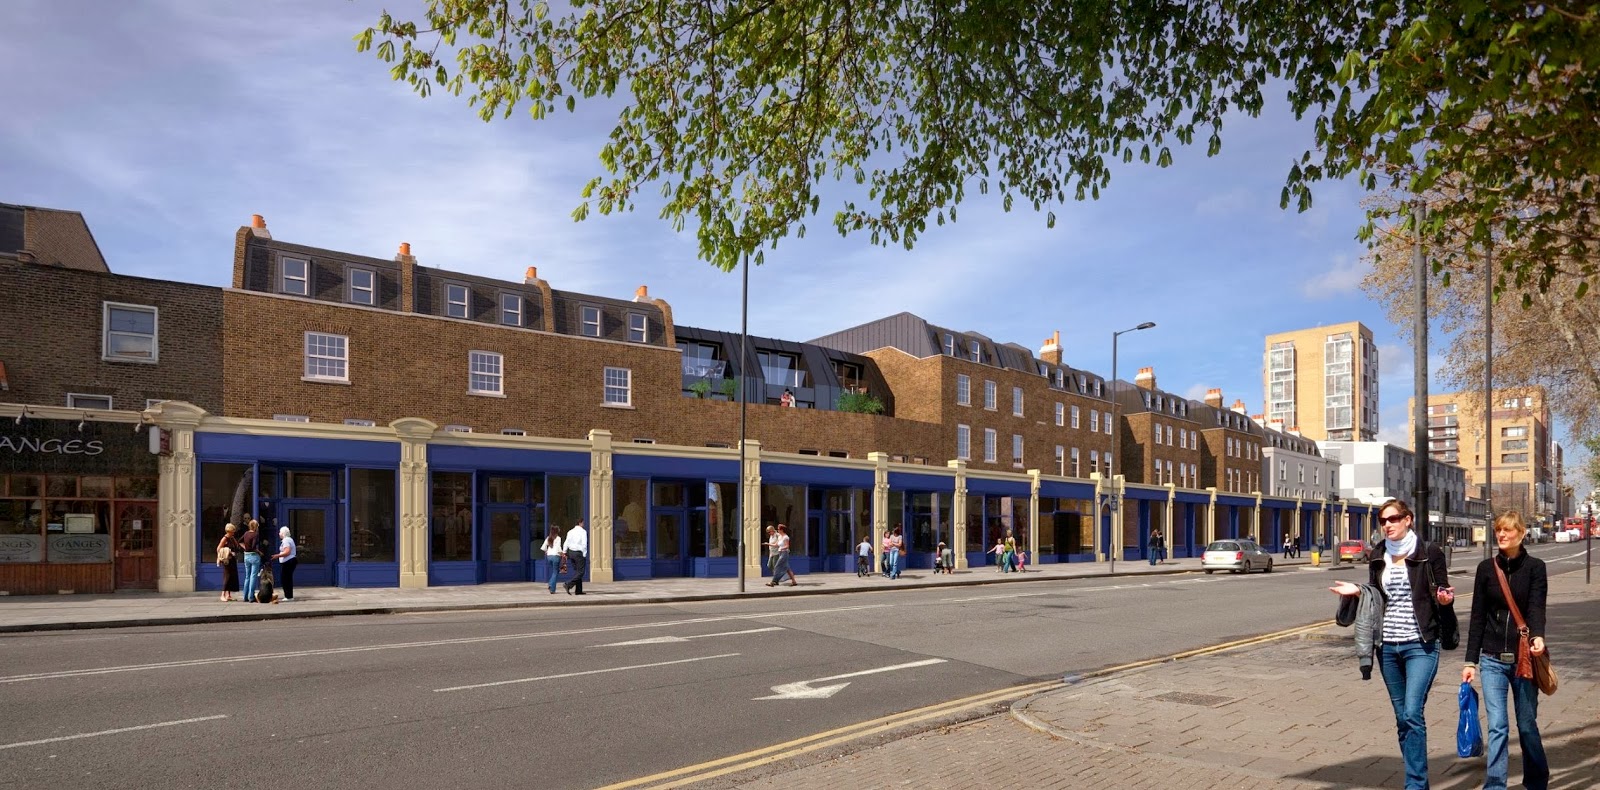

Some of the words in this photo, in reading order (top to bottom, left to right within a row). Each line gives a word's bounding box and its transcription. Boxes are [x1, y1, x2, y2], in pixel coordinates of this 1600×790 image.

[0, 436, 104, 456] ANGES
[0, 540, 33, 548] NGES
[55, 540, 102, 548] GANGES
